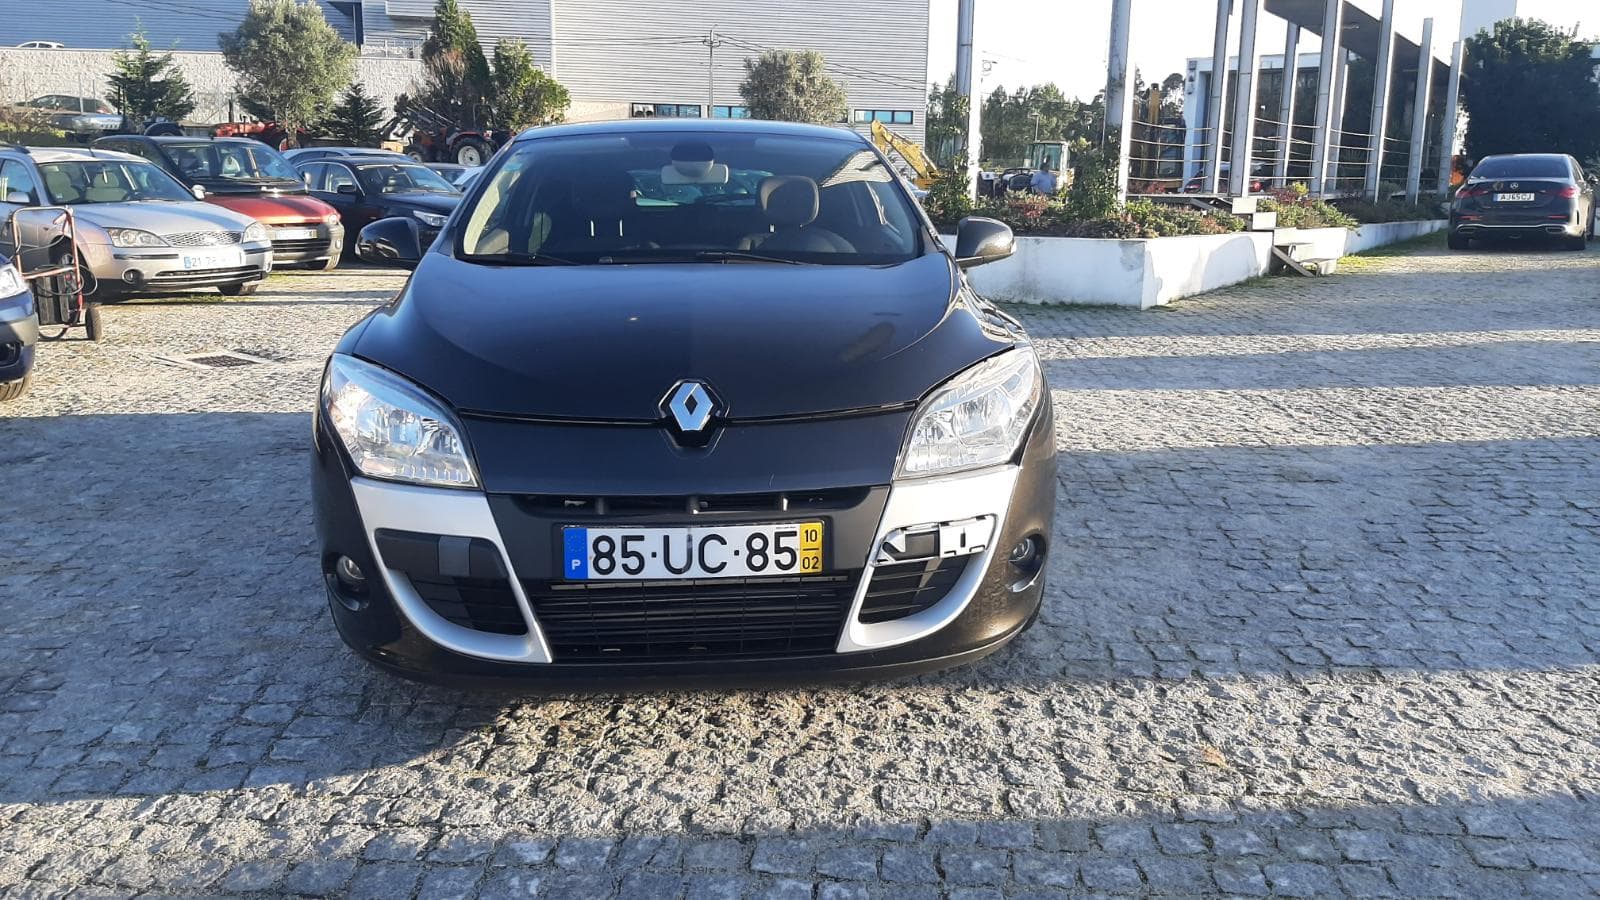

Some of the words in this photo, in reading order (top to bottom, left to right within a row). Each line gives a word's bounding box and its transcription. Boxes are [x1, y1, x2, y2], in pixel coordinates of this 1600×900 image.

[804, 529, 818, 543] 10
[571, 559, 581, 571] P
[802, 556, 819, 570] 02
